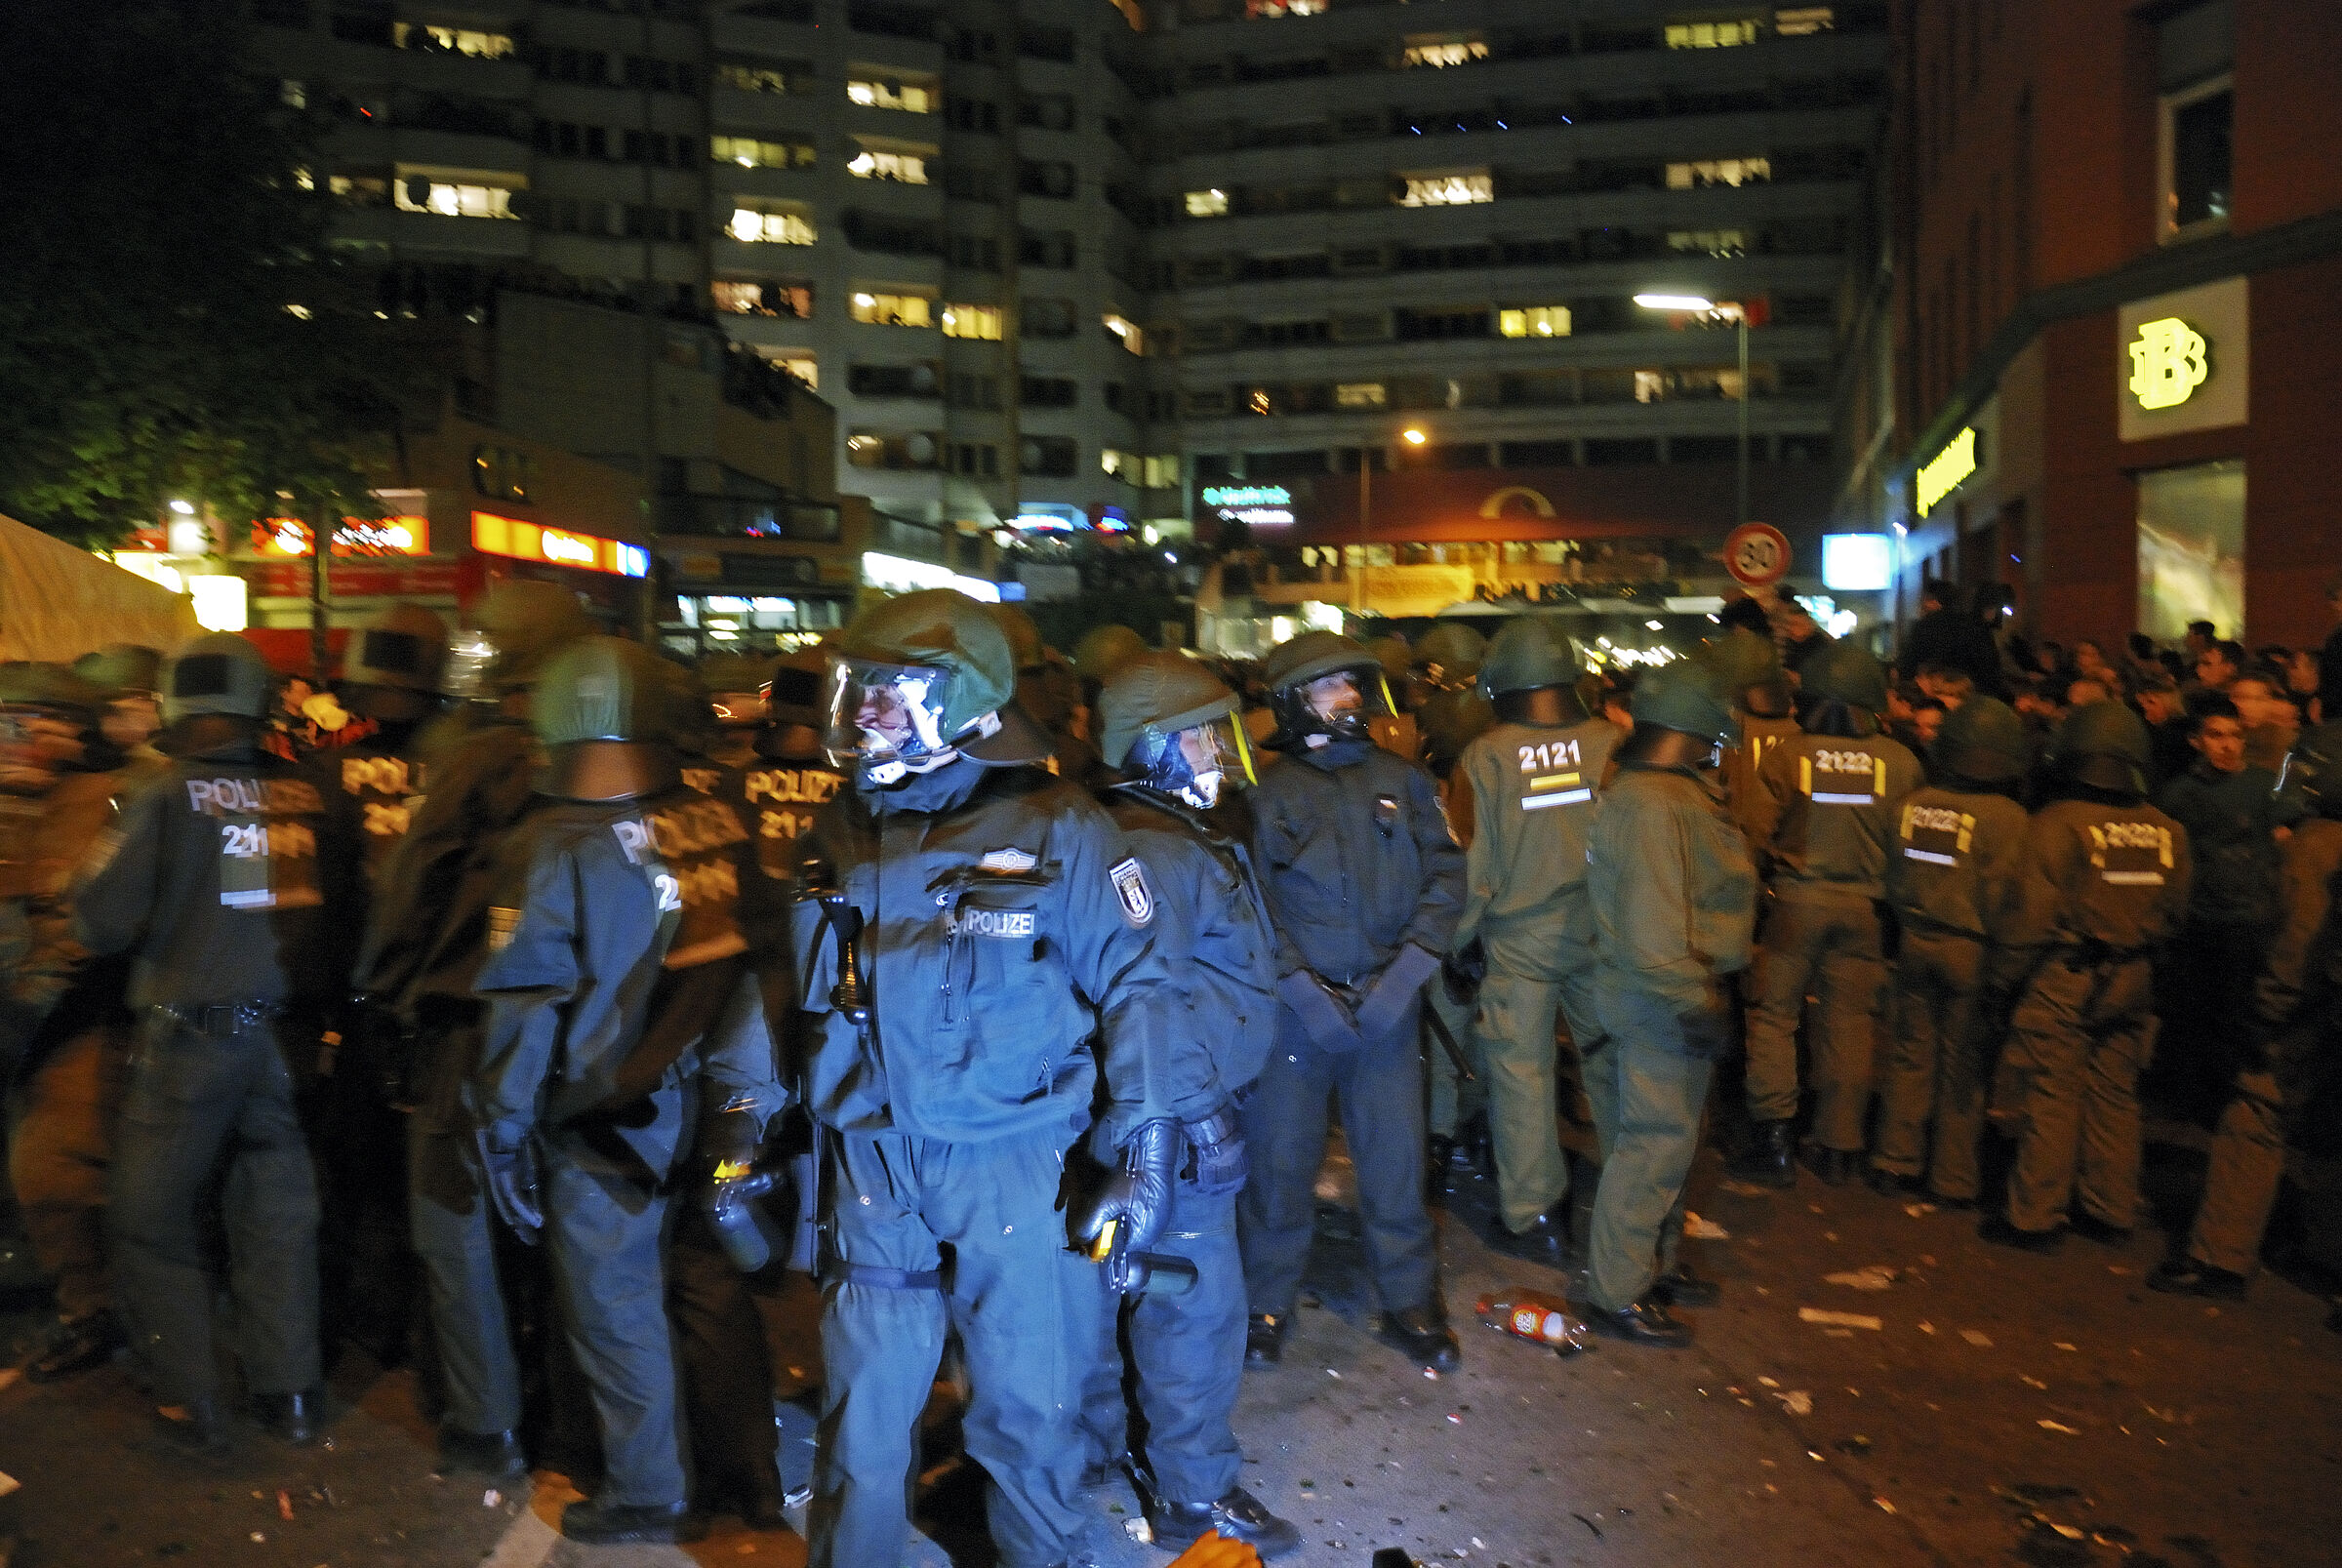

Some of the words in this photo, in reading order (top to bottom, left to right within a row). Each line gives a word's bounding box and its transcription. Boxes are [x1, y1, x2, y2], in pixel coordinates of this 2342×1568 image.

[1740, 539, 1777, 570] 30
[1518, 739, 1581, 774] 2121
[1815, 748, 1874, 775] 2122
[967, 909, 1034, 935] POLIZEI
